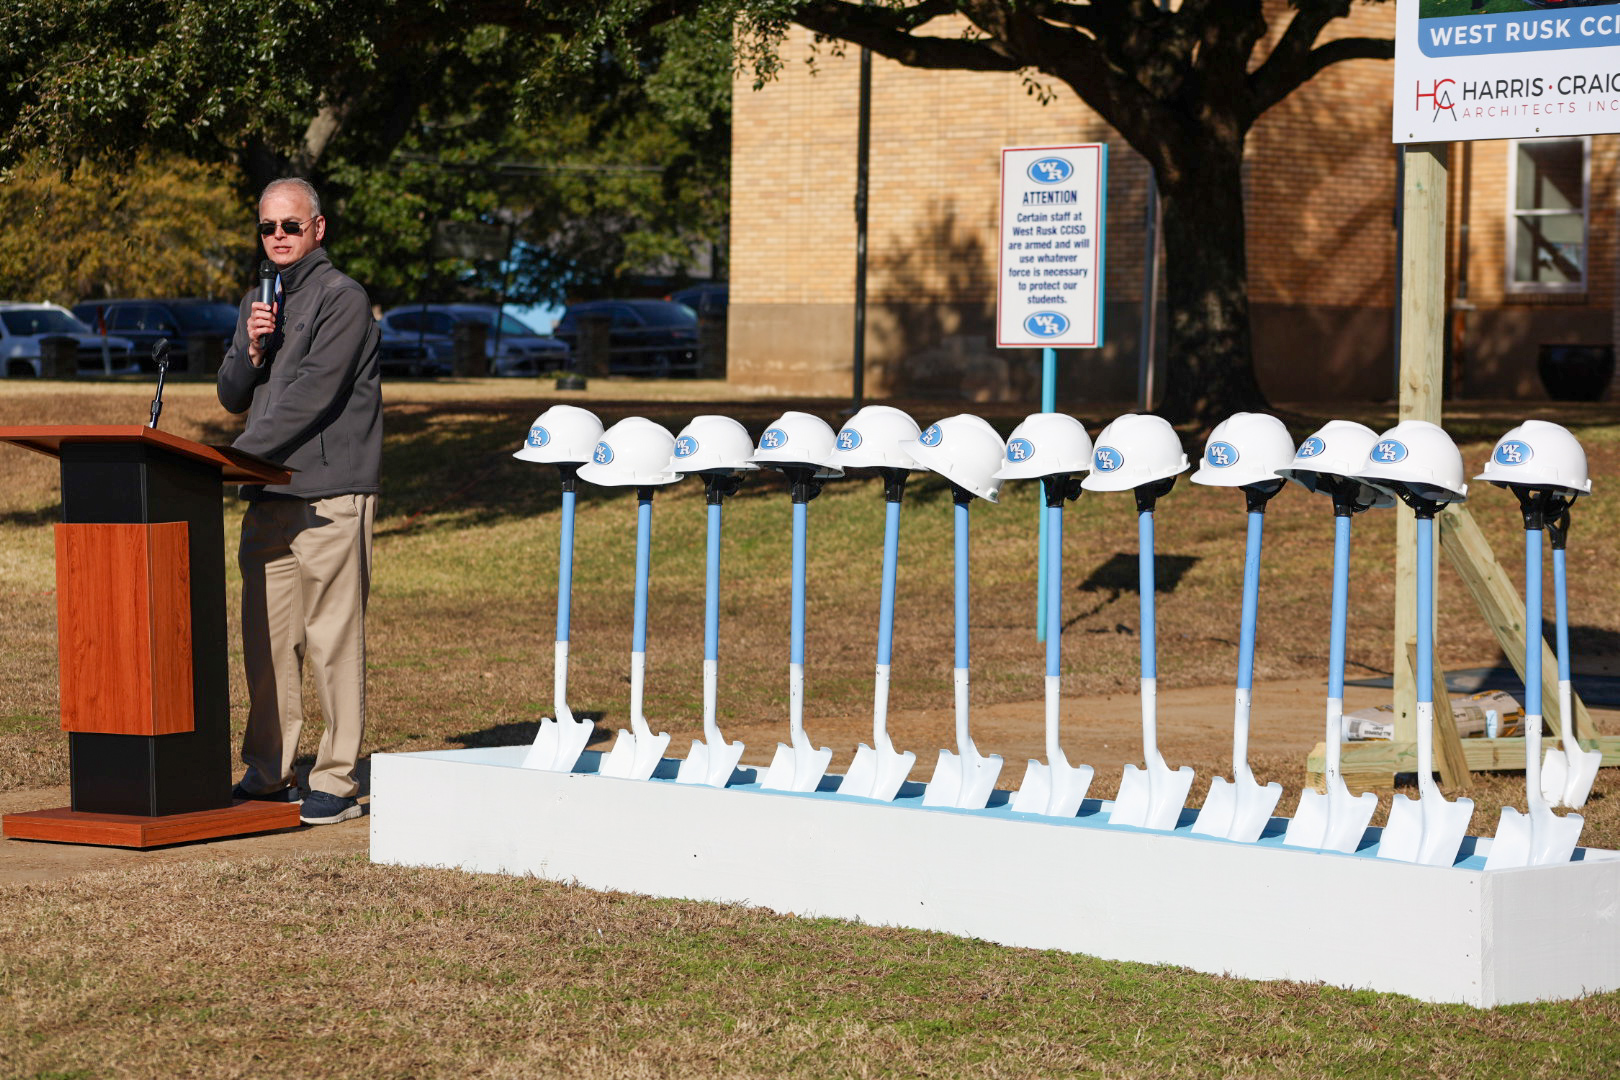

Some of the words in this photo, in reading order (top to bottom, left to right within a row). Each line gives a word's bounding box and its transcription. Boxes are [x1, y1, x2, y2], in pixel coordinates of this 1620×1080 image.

[1430, 24, 1497, 46] WEST
[1505, 19, 1571, 42] RUSK
[1462, 77, 1544, 101] HARRIS
[1462, 101, 1576, 119] ARCHITECTS
[1023, 190, 1077, 205] ATTENTION
[1016, 213, 1048, 223] Certain
[1050, 211, 1071, 221] staff
[1073, 211, 1083, 221] at
[1012, 226, 1034, 236] West
[1036, 226, 1057, 236] Rusk
[1060, 225, 1086, 235] CCISD
[1008, 242, 1022, 250] are
[1024, 240, 1052, 250] armed
[1055, 239, 1071, 249] and
[1073, 238, 1090, 249] will
[1019, 255, 1034, 263] use
[1037, 253, 1078, 263] whatever
[1008, 267, 1031, 277] force
[1033, 268, 1040, 277] is
[1043, 267, 1088, 278] necessary
[1018, 281, 1027, 291] to
[1029, 280, 1061, 292] protect
[1063, 281, 1078, 290] our
[1027, 294, 1068, 304] students.
